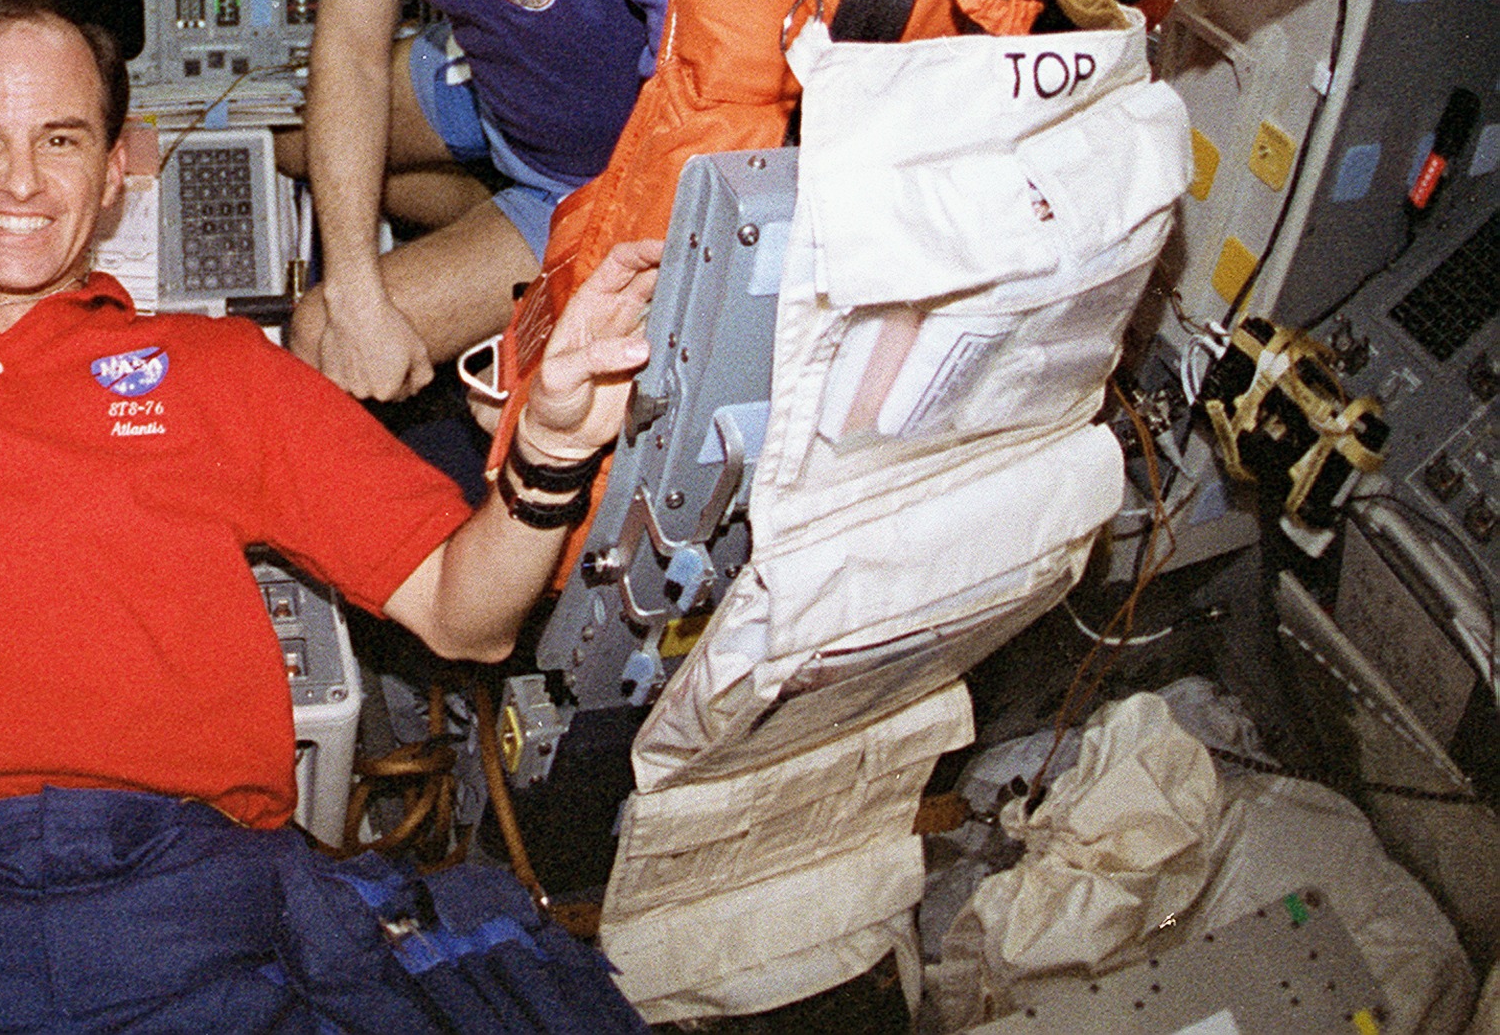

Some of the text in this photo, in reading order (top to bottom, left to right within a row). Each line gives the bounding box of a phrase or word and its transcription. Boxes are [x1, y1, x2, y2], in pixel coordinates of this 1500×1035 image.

[1004, 51, 1096, 99] TOP
[108, 400, 164, 417] STS-76
[110, 421, 166, 437] Atlantis
